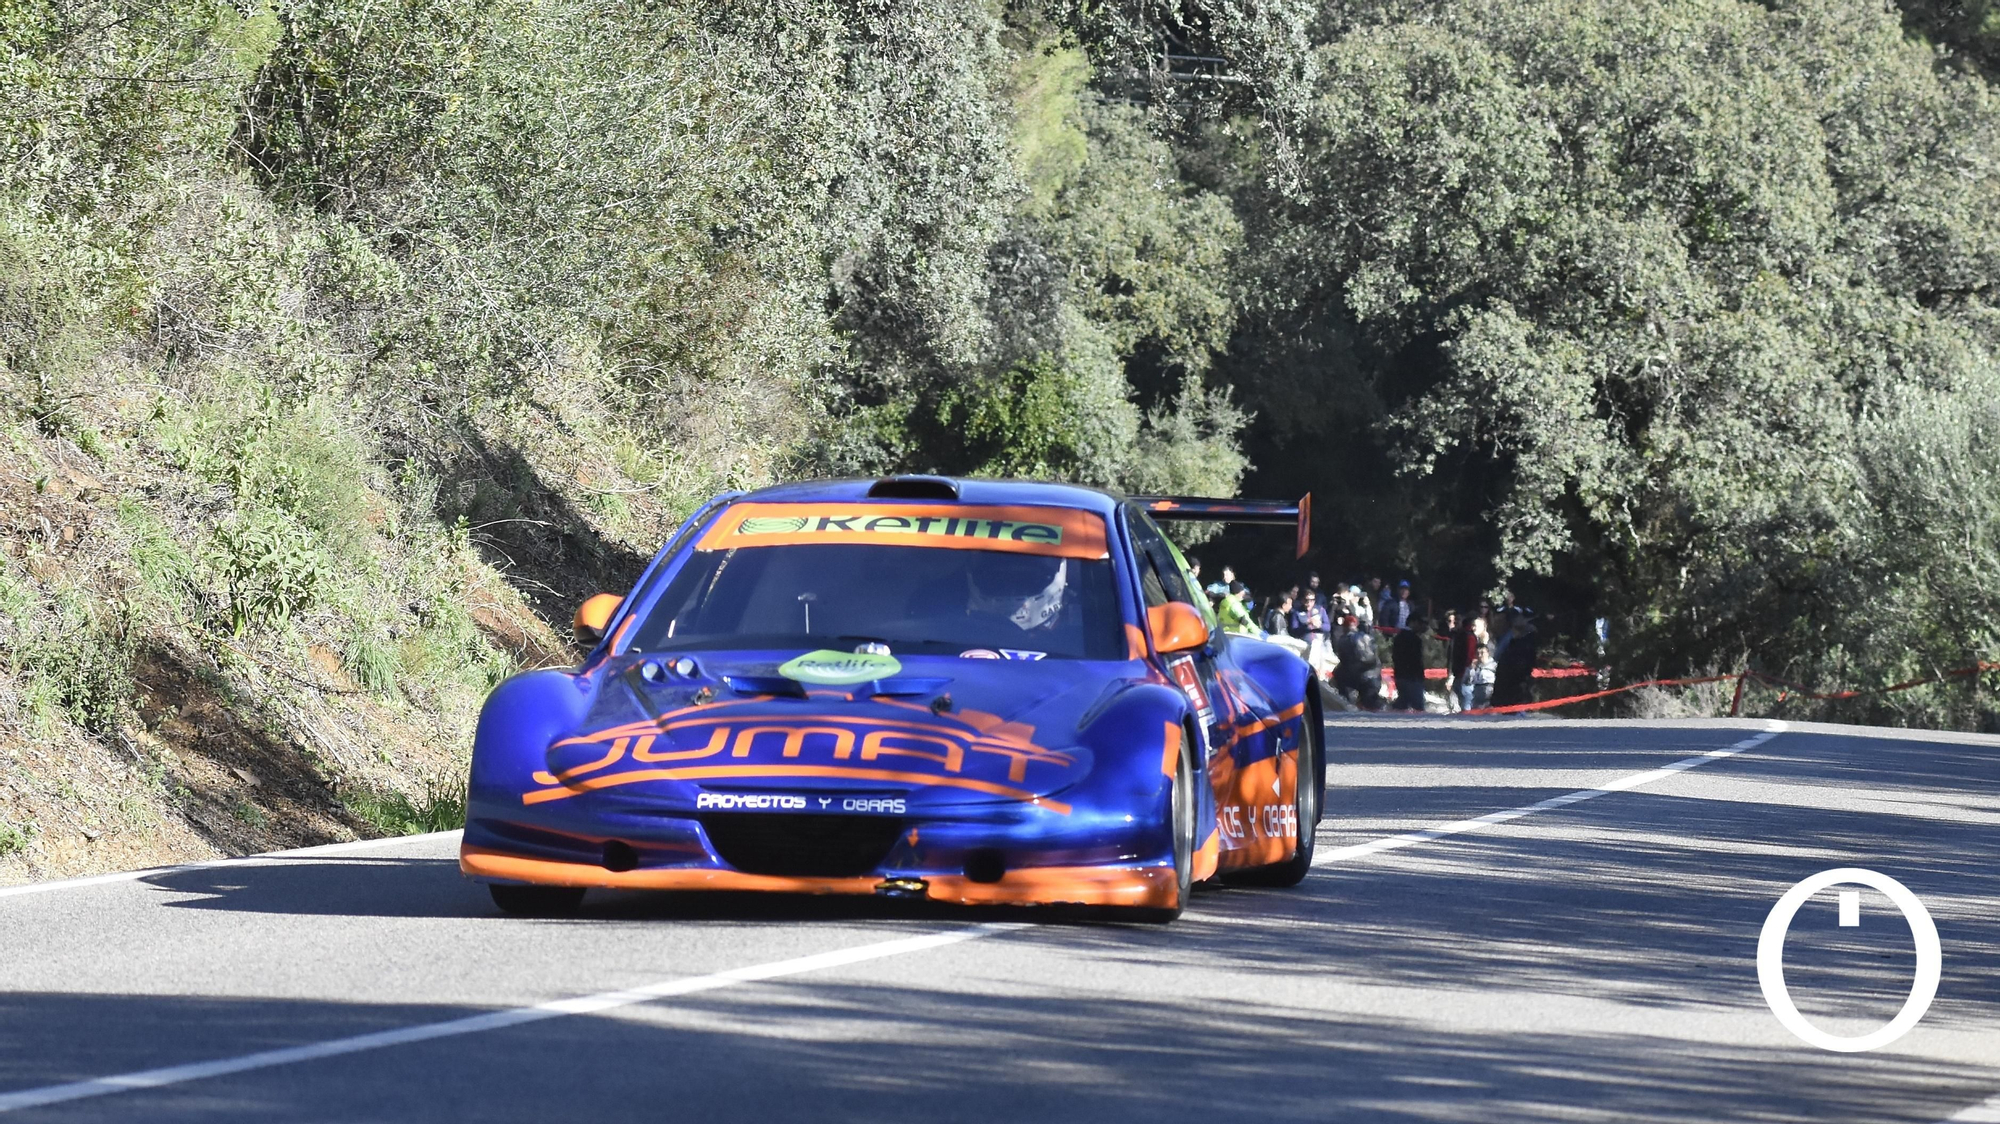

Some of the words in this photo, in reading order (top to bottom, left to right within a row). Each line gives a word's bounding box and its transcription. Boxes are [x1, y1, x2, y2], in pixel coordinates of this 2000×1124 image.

[697, 793, 807, 809] PROYECTOS
[818, 797, 832, 809] Y
[842, 799, 906, 813] OBRAS
[1248, 805, 1258, 838] Y
